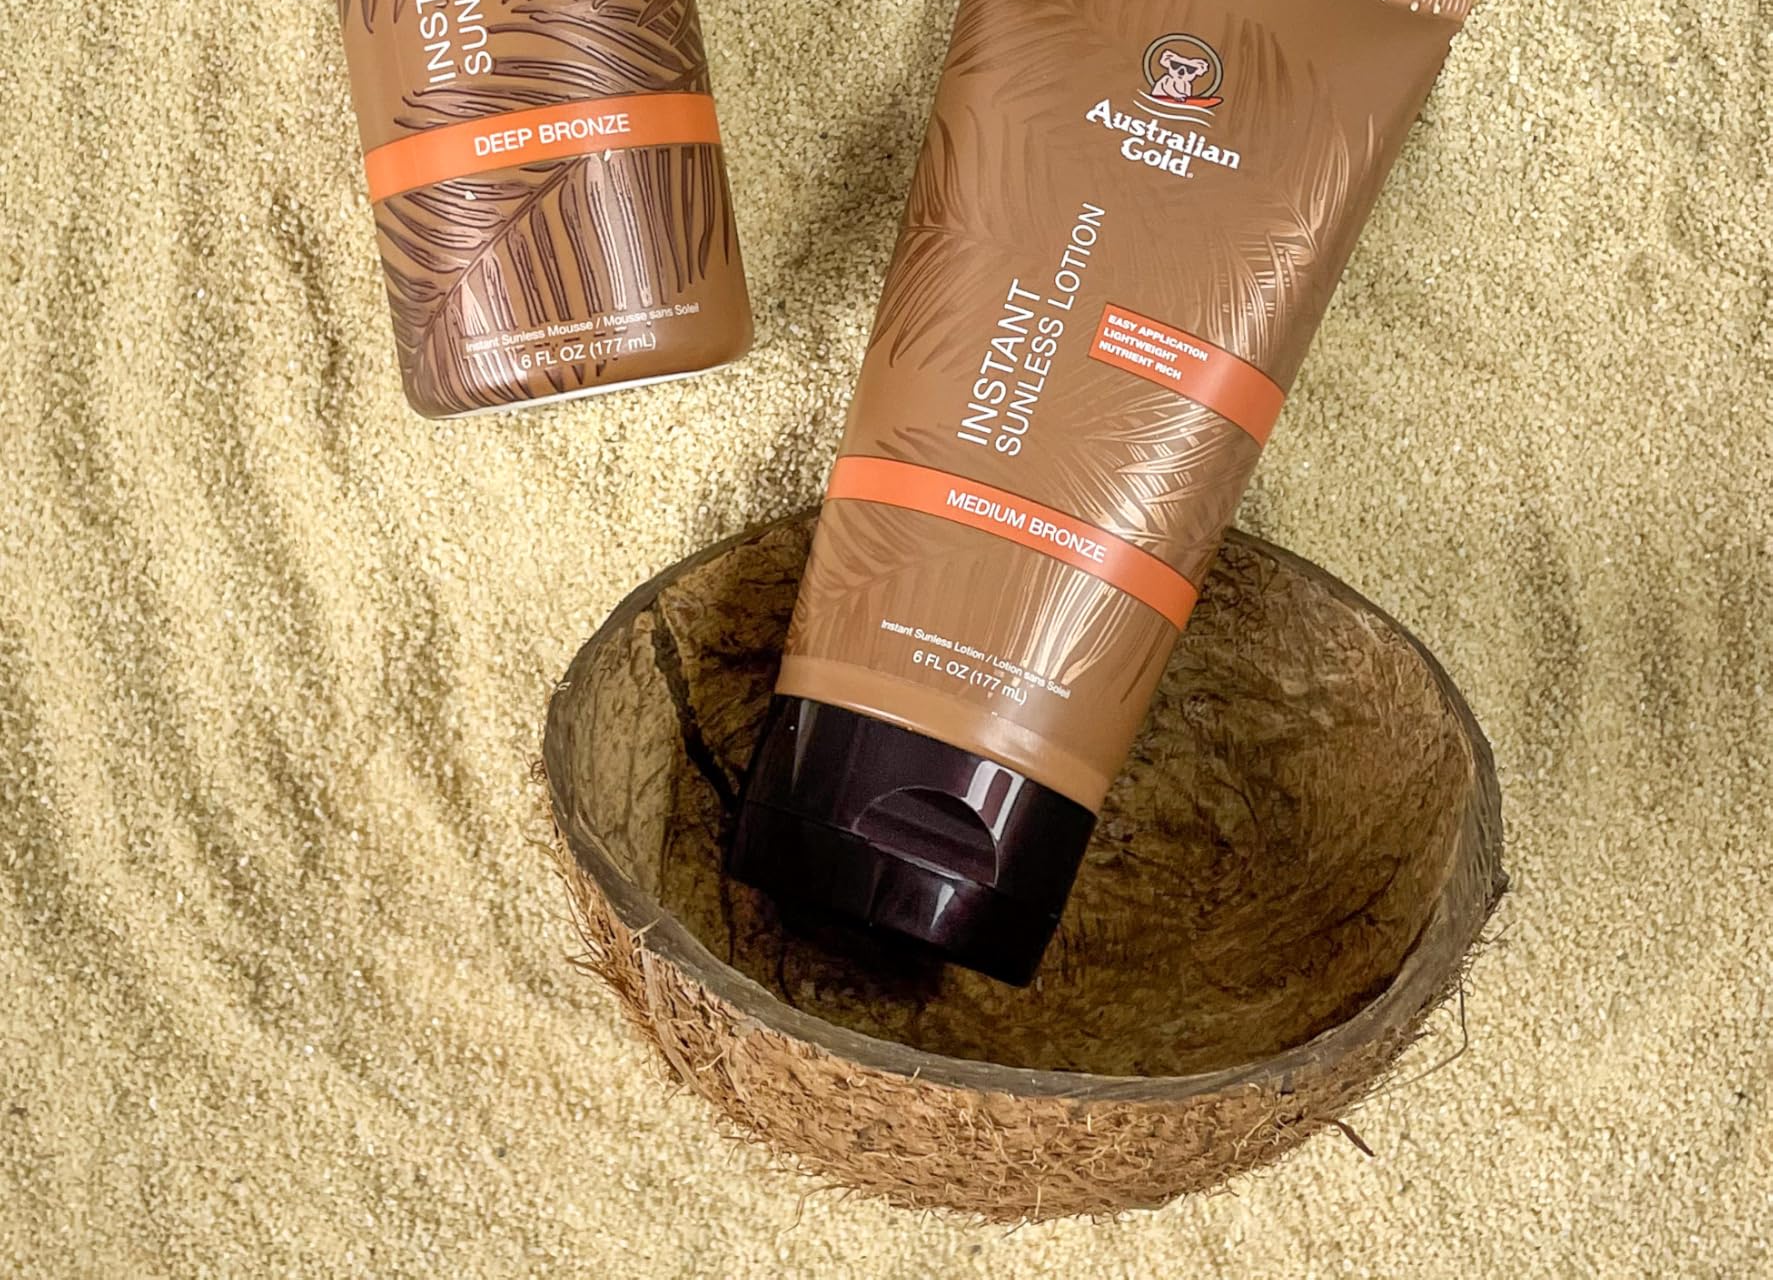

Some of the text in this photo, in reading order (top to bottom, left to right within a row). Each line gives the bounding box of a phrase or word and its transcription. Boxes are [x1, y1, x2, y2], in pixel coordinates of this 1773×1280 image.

[474, 113, 631, 157] DEEP BRONZE
[1085, 99, 1241, 170] Australian
[1121, 137, 1191, 177] Gold
[465, 337, 500, 353] Instant
[501, 329, 546, 346] Sunless
[547, 320, 593, 337] Mousse
[603, 311, 648, 327] Mousse
[648, 307, 674, 320] sans
[674, 302, 700, 316] Soleil
[521, 332, 656, 369] 6 FL OZ (177 mL)
[995, 202, 1105, 456] SUNLESS LOTION
[1103, 327, 1178, 362] LIGHTWEIGHT
[1107, 314, 1209, 361] EASY APPLICATION
[957, 278, 1041, 446] INSTANT
[1099, 340, 1182, 380] NUTRIENT RICH
[946, 489, 1107, 563] MEDIUM BRONZE
[880, 619, 914, 637] Instant
[914, 628, 953, 650] Sunless
[954, 641, 985, 662] Lotion
[993, 656, 1024, 677] Lotion
[1024, 670, 1046, 688] sans
[1046, 680, 1071, 700] Soleil
[912, 650, 1028, 706] 6 FL OZ (177 mL)
